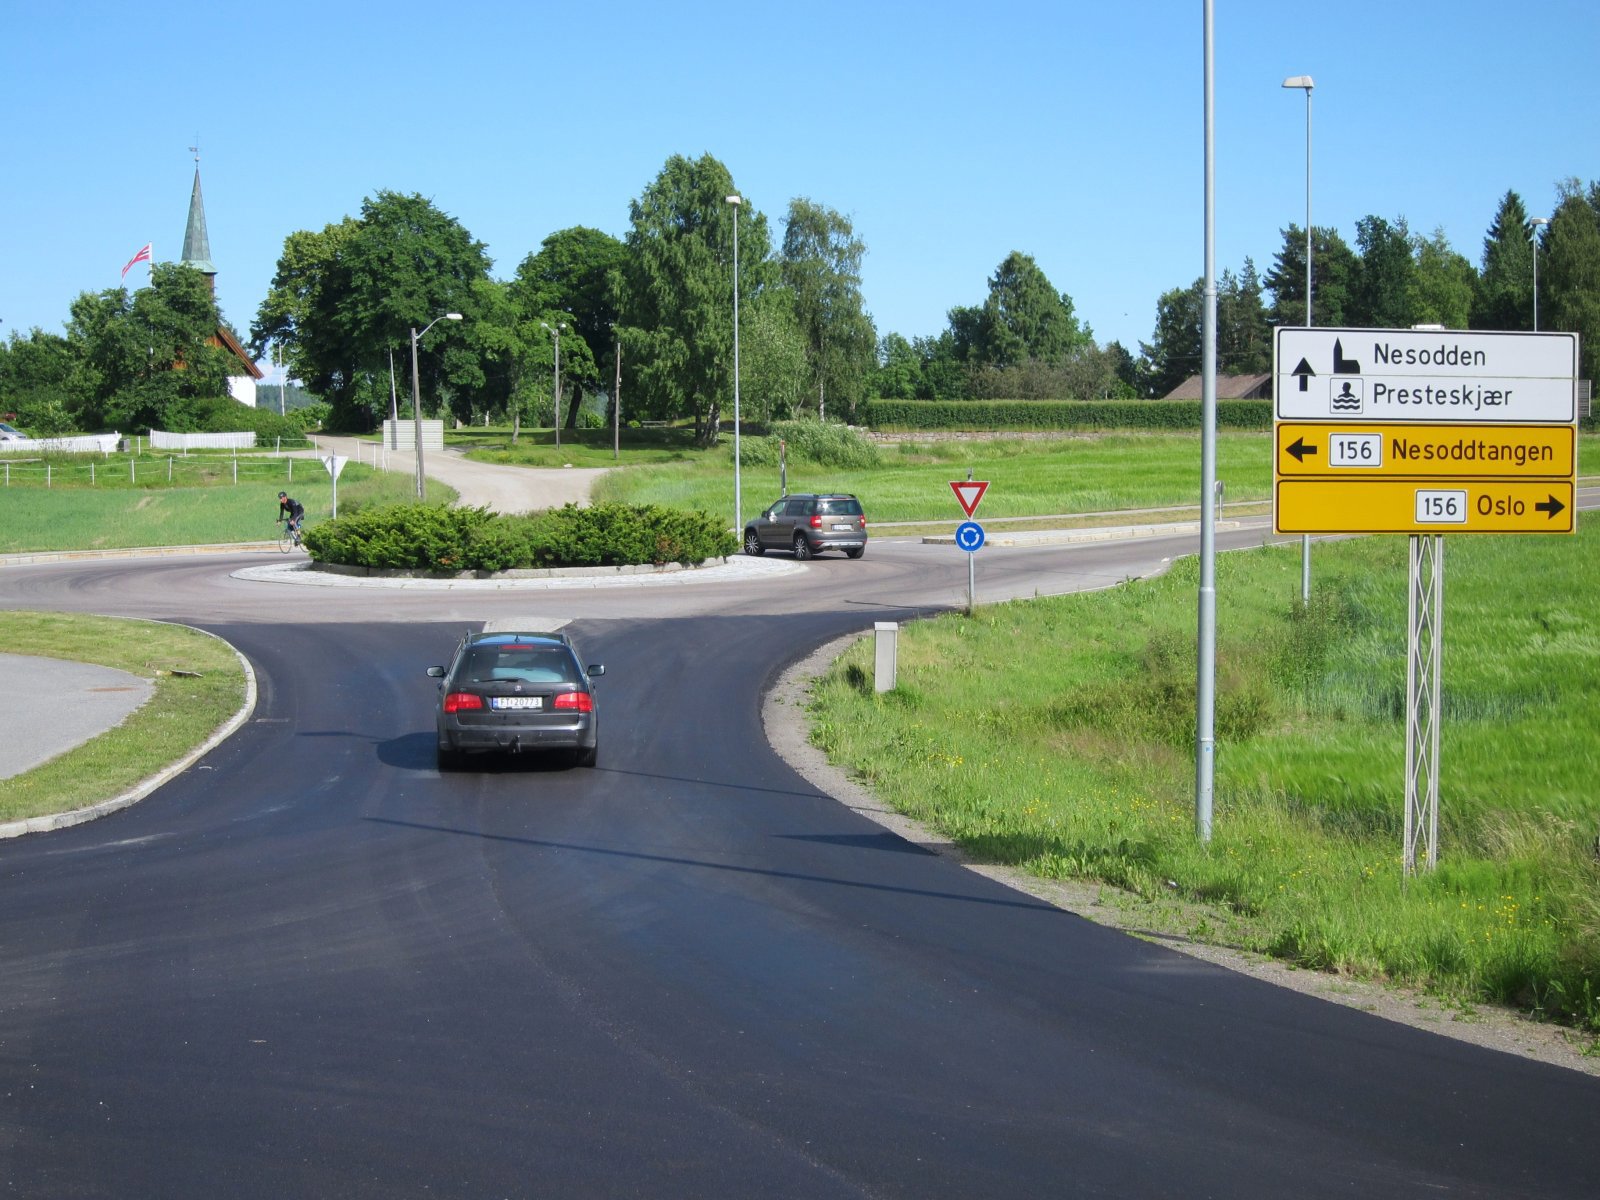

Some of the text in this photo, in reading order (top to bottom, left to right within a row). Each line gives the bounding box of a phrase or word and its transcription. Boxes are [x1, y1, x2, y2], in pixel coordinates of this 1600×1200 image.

[1374, 343, 1486, 366] Nesodden
[1373, 383, 1513, 411] Presteskjær
[1338, 438, 1554, 466] 156 Nesoddtangen
[1424, 494, 1526, 516] 156 Oslo
